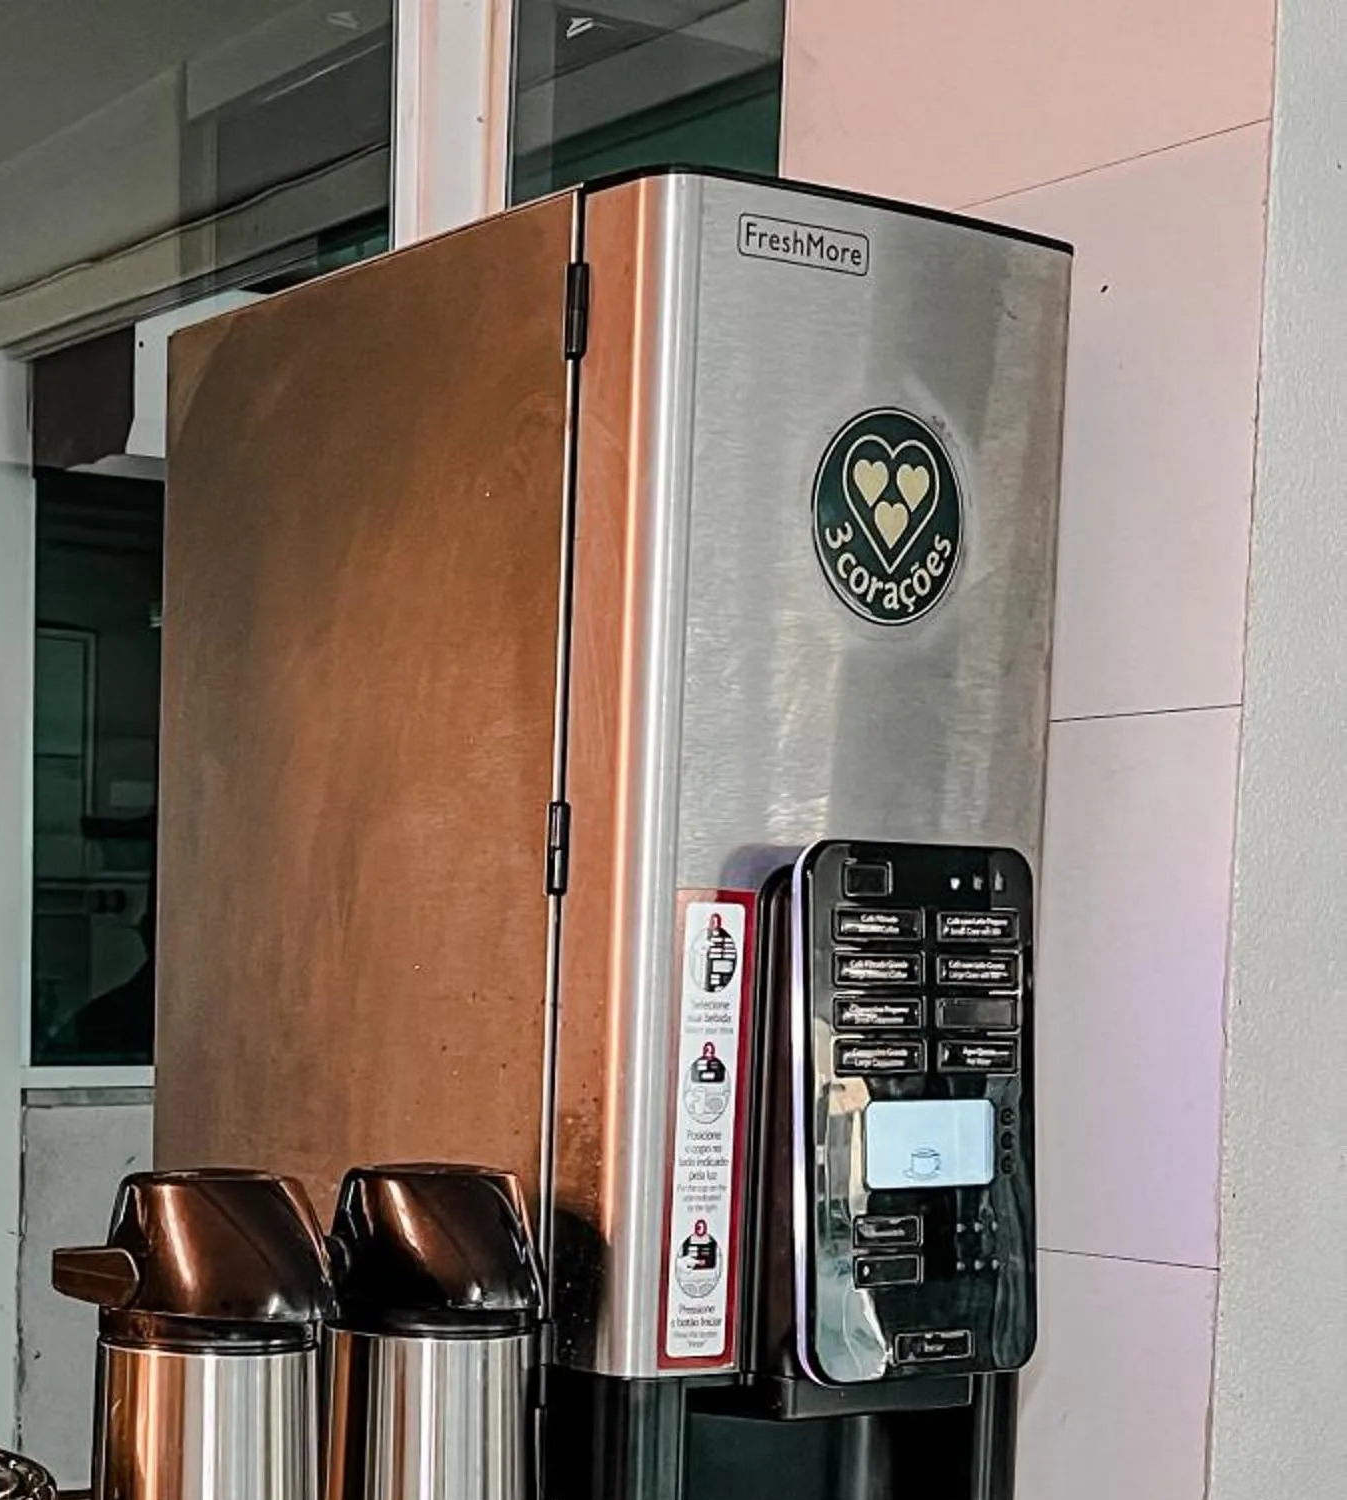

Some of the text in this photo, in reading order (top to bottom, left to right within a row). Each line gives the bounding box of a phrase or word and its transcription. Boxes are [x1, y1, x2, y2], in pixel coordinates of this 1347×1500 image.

[745, 221, 862, 266] FreshMore
[825, 521, 953, 614] 3 corações
